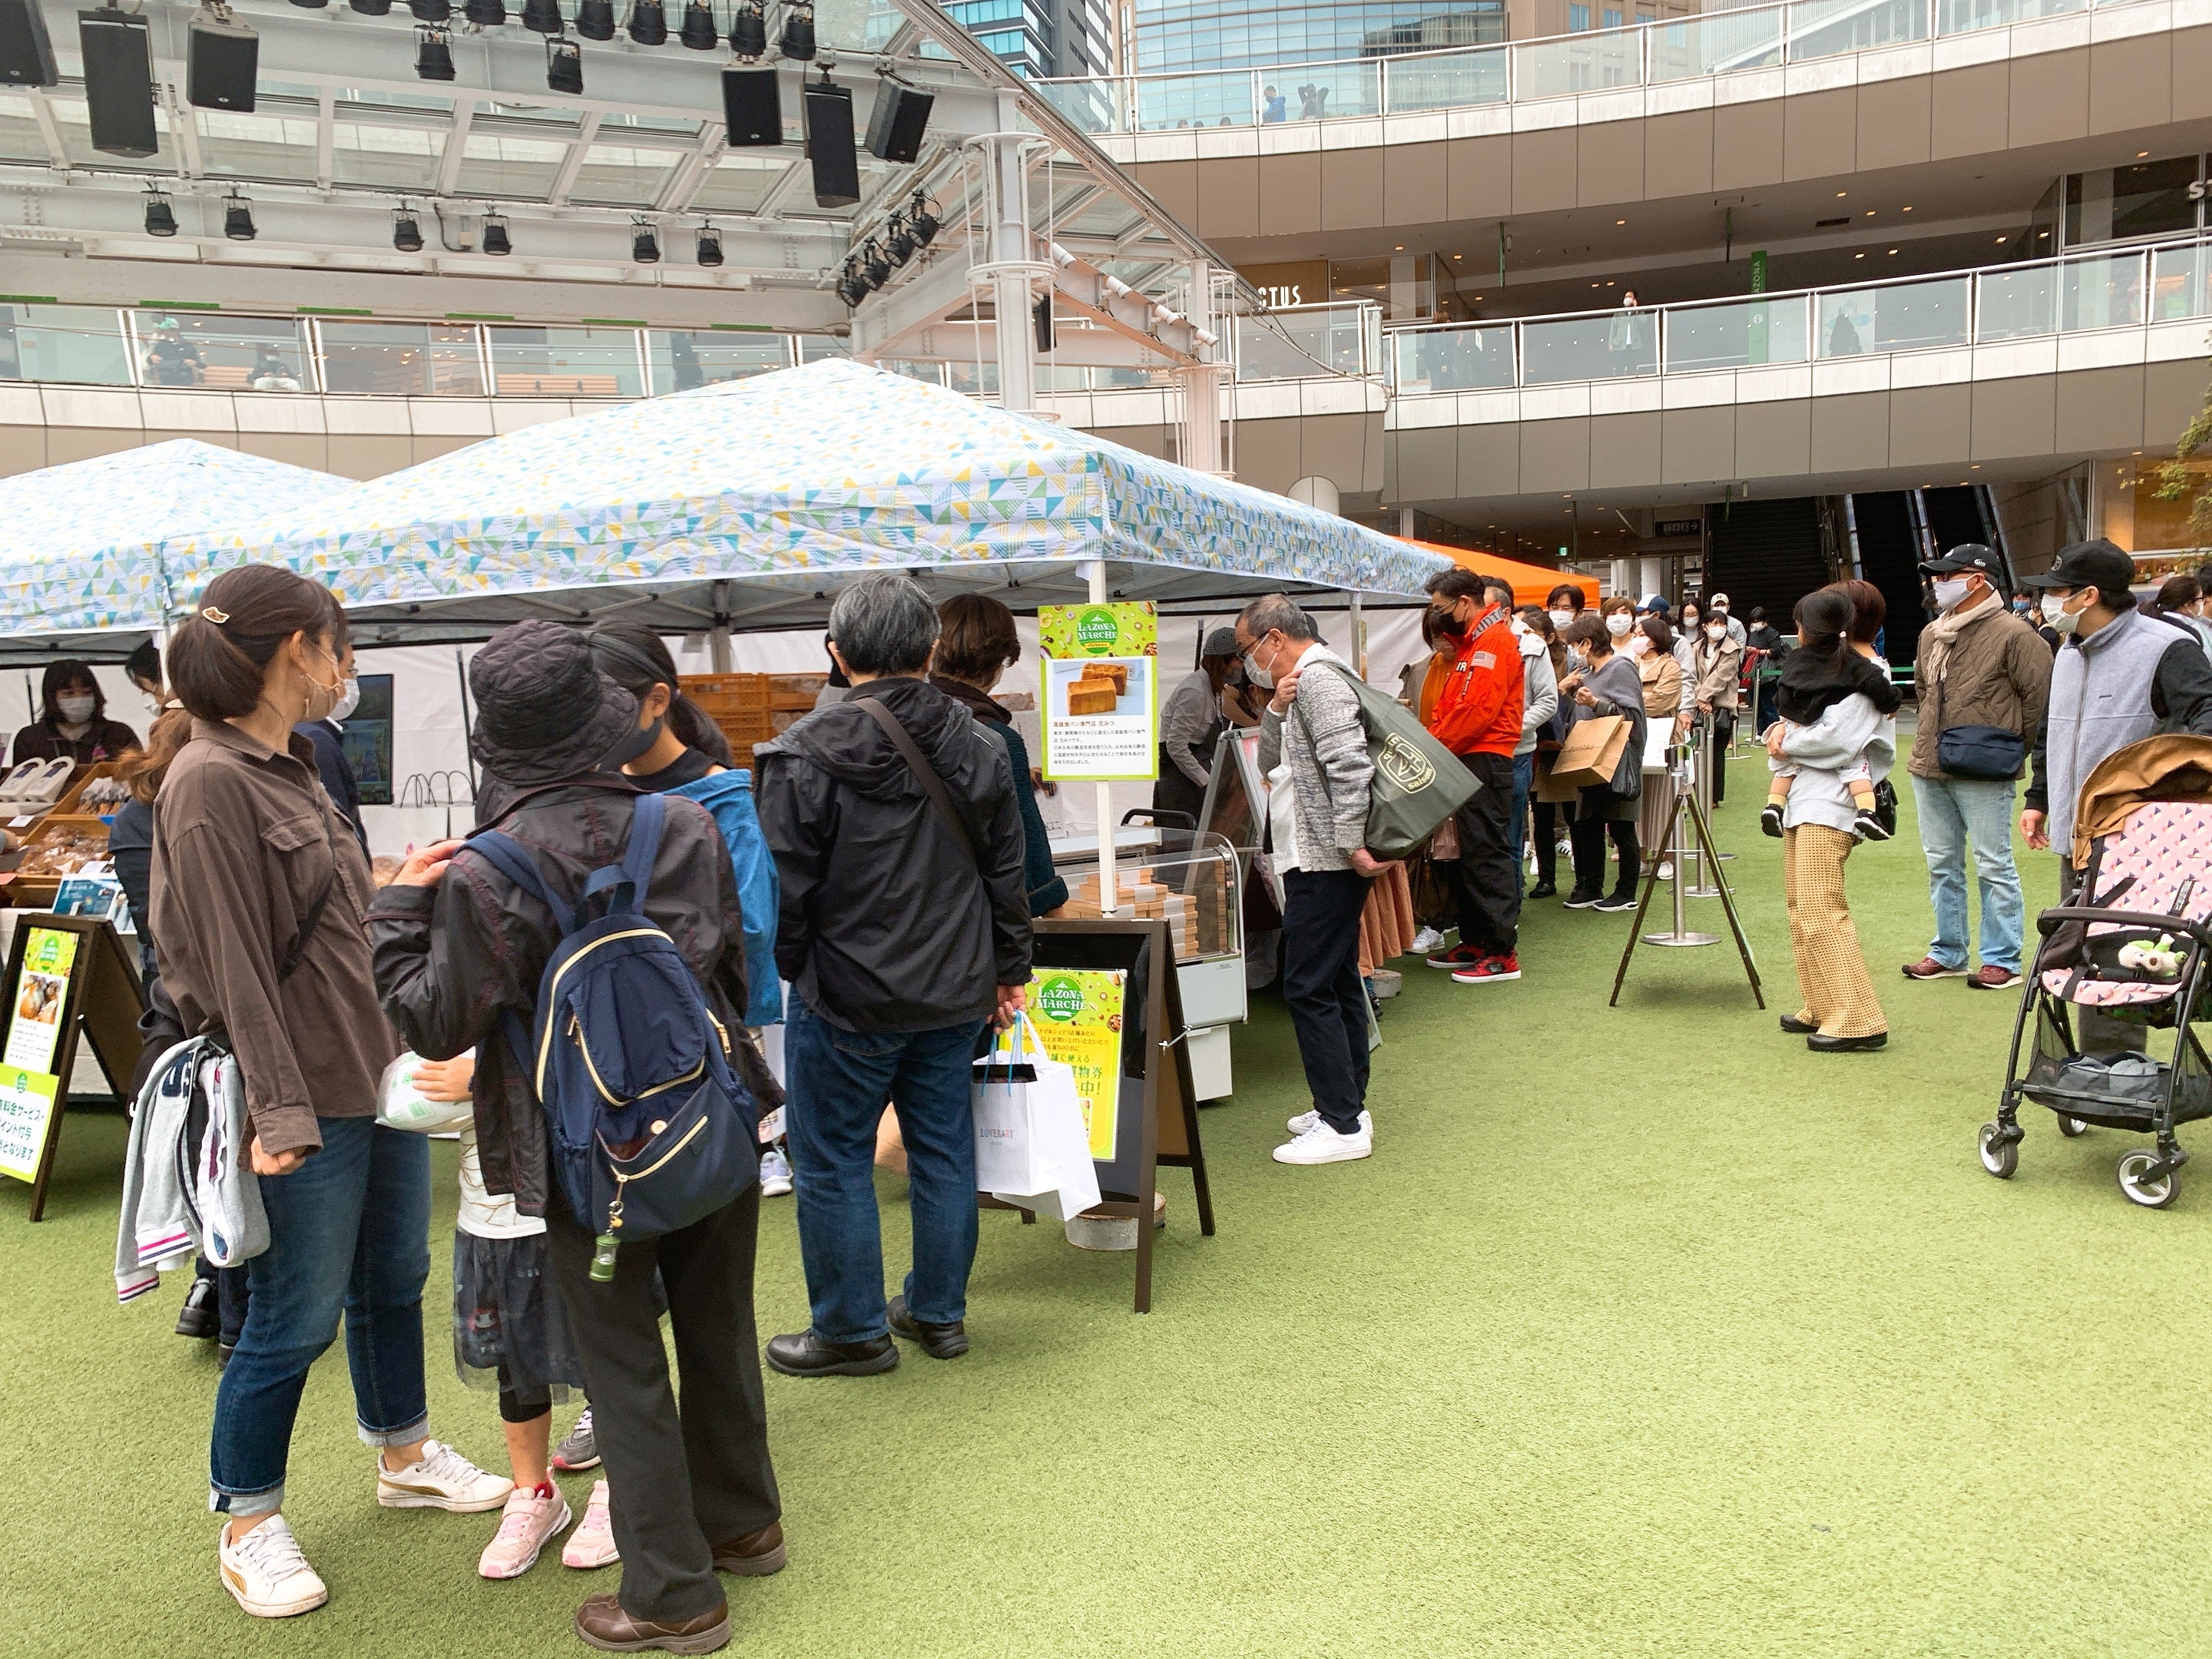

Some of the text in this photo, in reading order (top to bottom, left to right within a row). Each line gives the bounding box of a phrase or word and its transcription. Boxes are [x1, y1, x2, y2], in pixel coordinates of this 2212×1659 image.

[1258, 284, 1301, 307] CTUS
[1077, 622, 1117, 632] LAZONA
[1077, 631, 1118, 641] MARCHE
[1037, 986, 1087, 1001] LAZONA
[1037, 998, 1088, 1012] MARCHE
[0, 1117, 32, 1141] イント付与
